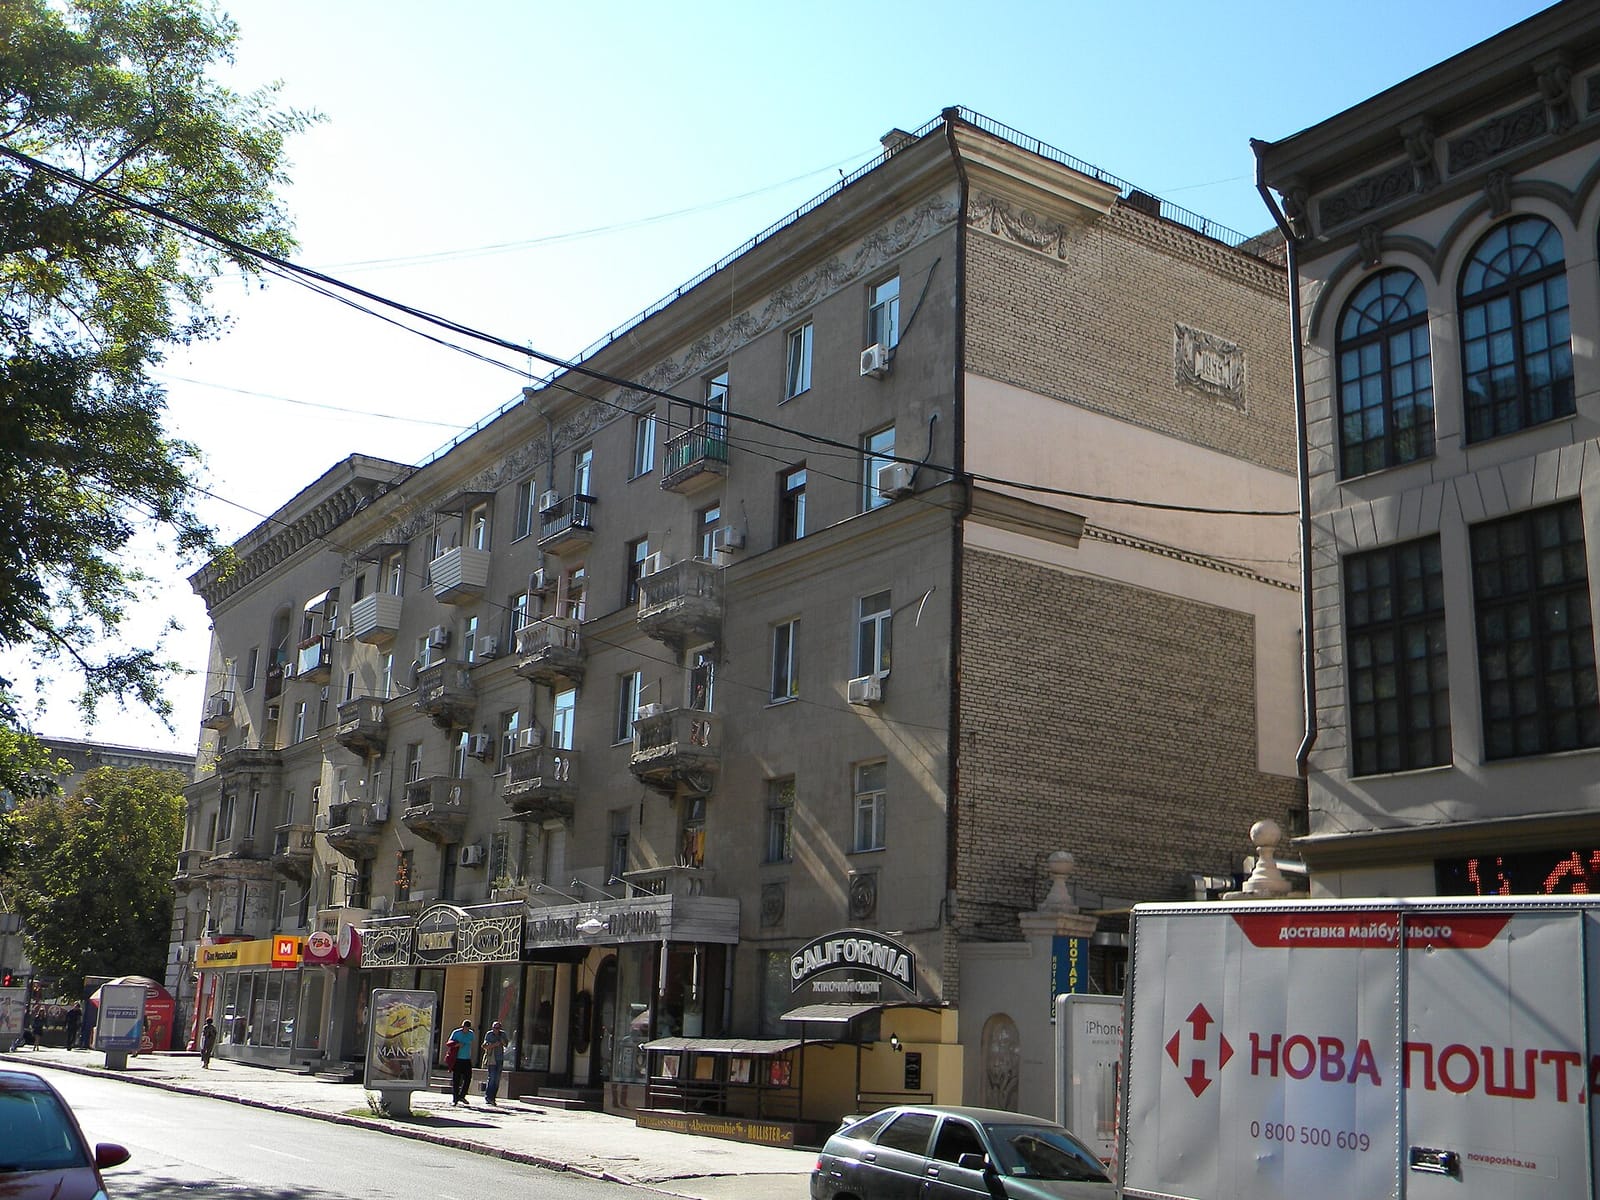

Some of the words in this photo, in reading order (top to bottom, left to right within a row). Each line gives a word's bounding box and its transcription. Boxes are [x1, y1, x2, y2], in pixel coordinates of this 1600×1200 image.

[1279, 925, 1345, 940] доставка
[791, 938, 910, 982] CALIFORNIA
[1069, 938, 1078, 993] НОТАРІ
[1249, 1032, 1382, 1087] НОВА
[691, 1119, 736, 1136] Abercrombie
[747, 1123, 781, 1142] HOLLISTER
[1250, 1121, 1260, 1139] 0
[1265, 1123, 1296, 1143] 800
[1300, 1126, 1331, 1147] 500
[1336, 1130, 1370, 1152] 609
[1467, 1152, 1537, 1170] novaposhta.ua
